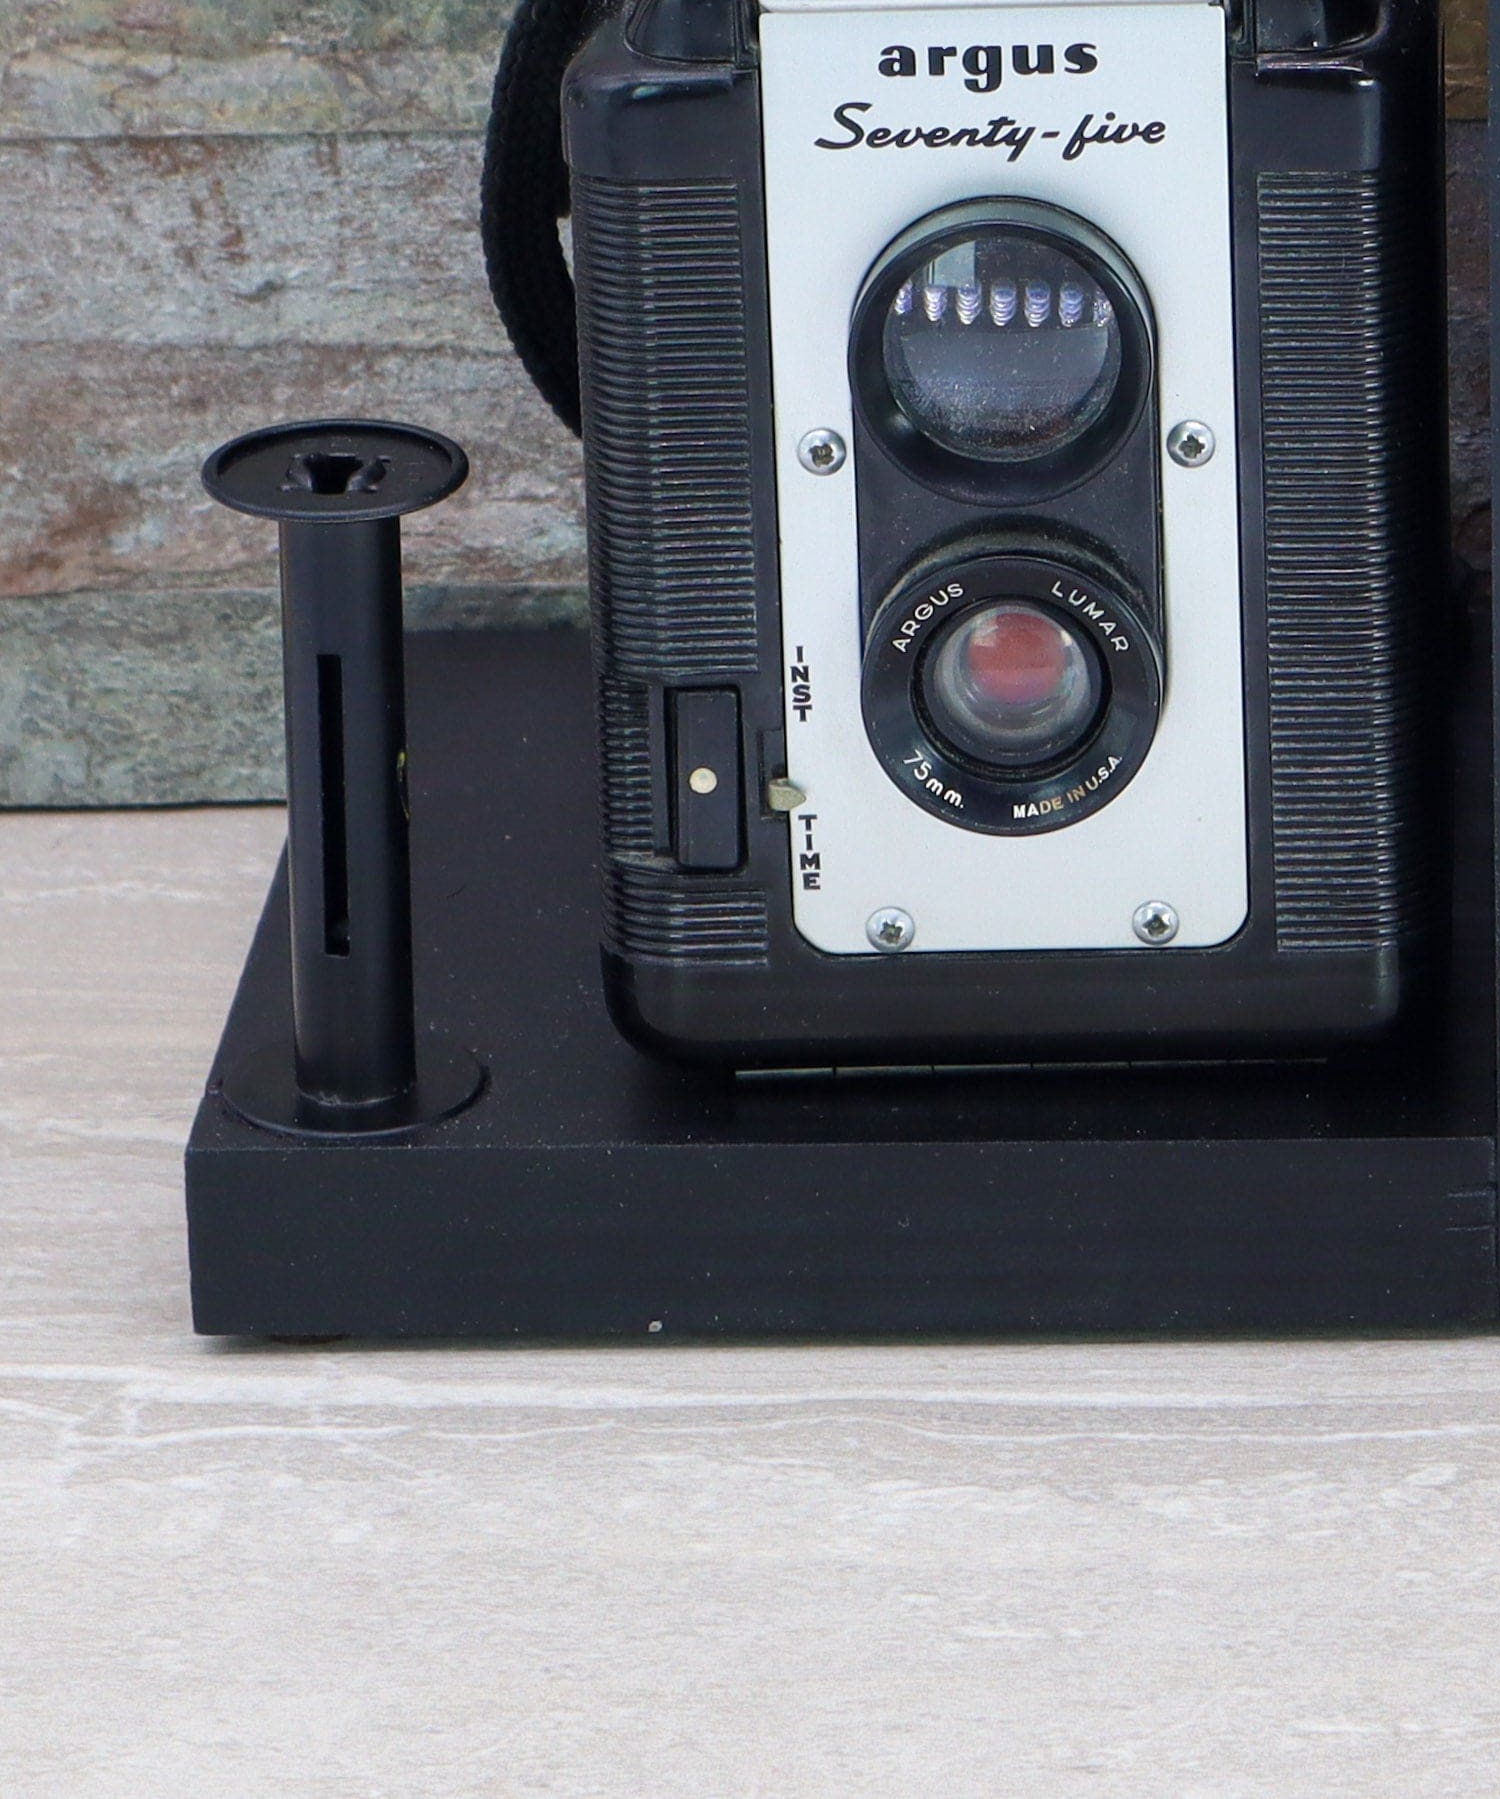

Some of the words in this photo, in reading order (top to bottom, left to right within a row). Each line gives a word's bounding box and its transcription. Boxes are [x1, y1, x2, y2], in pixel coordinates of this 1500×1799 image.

[877, 41, 1099, 94] argus
[814, 101, 1167, 163] Seventy-five
[891, 582, 965, 654] ARGUS
[1050, 580, 1130, 654] LUMAR
[789, 644, 814, 723] INST
[1012, 796, 1065, 820] MADE
[1067, 784, 1086, 805] IN
[796, 813, 822, 892] TIME
